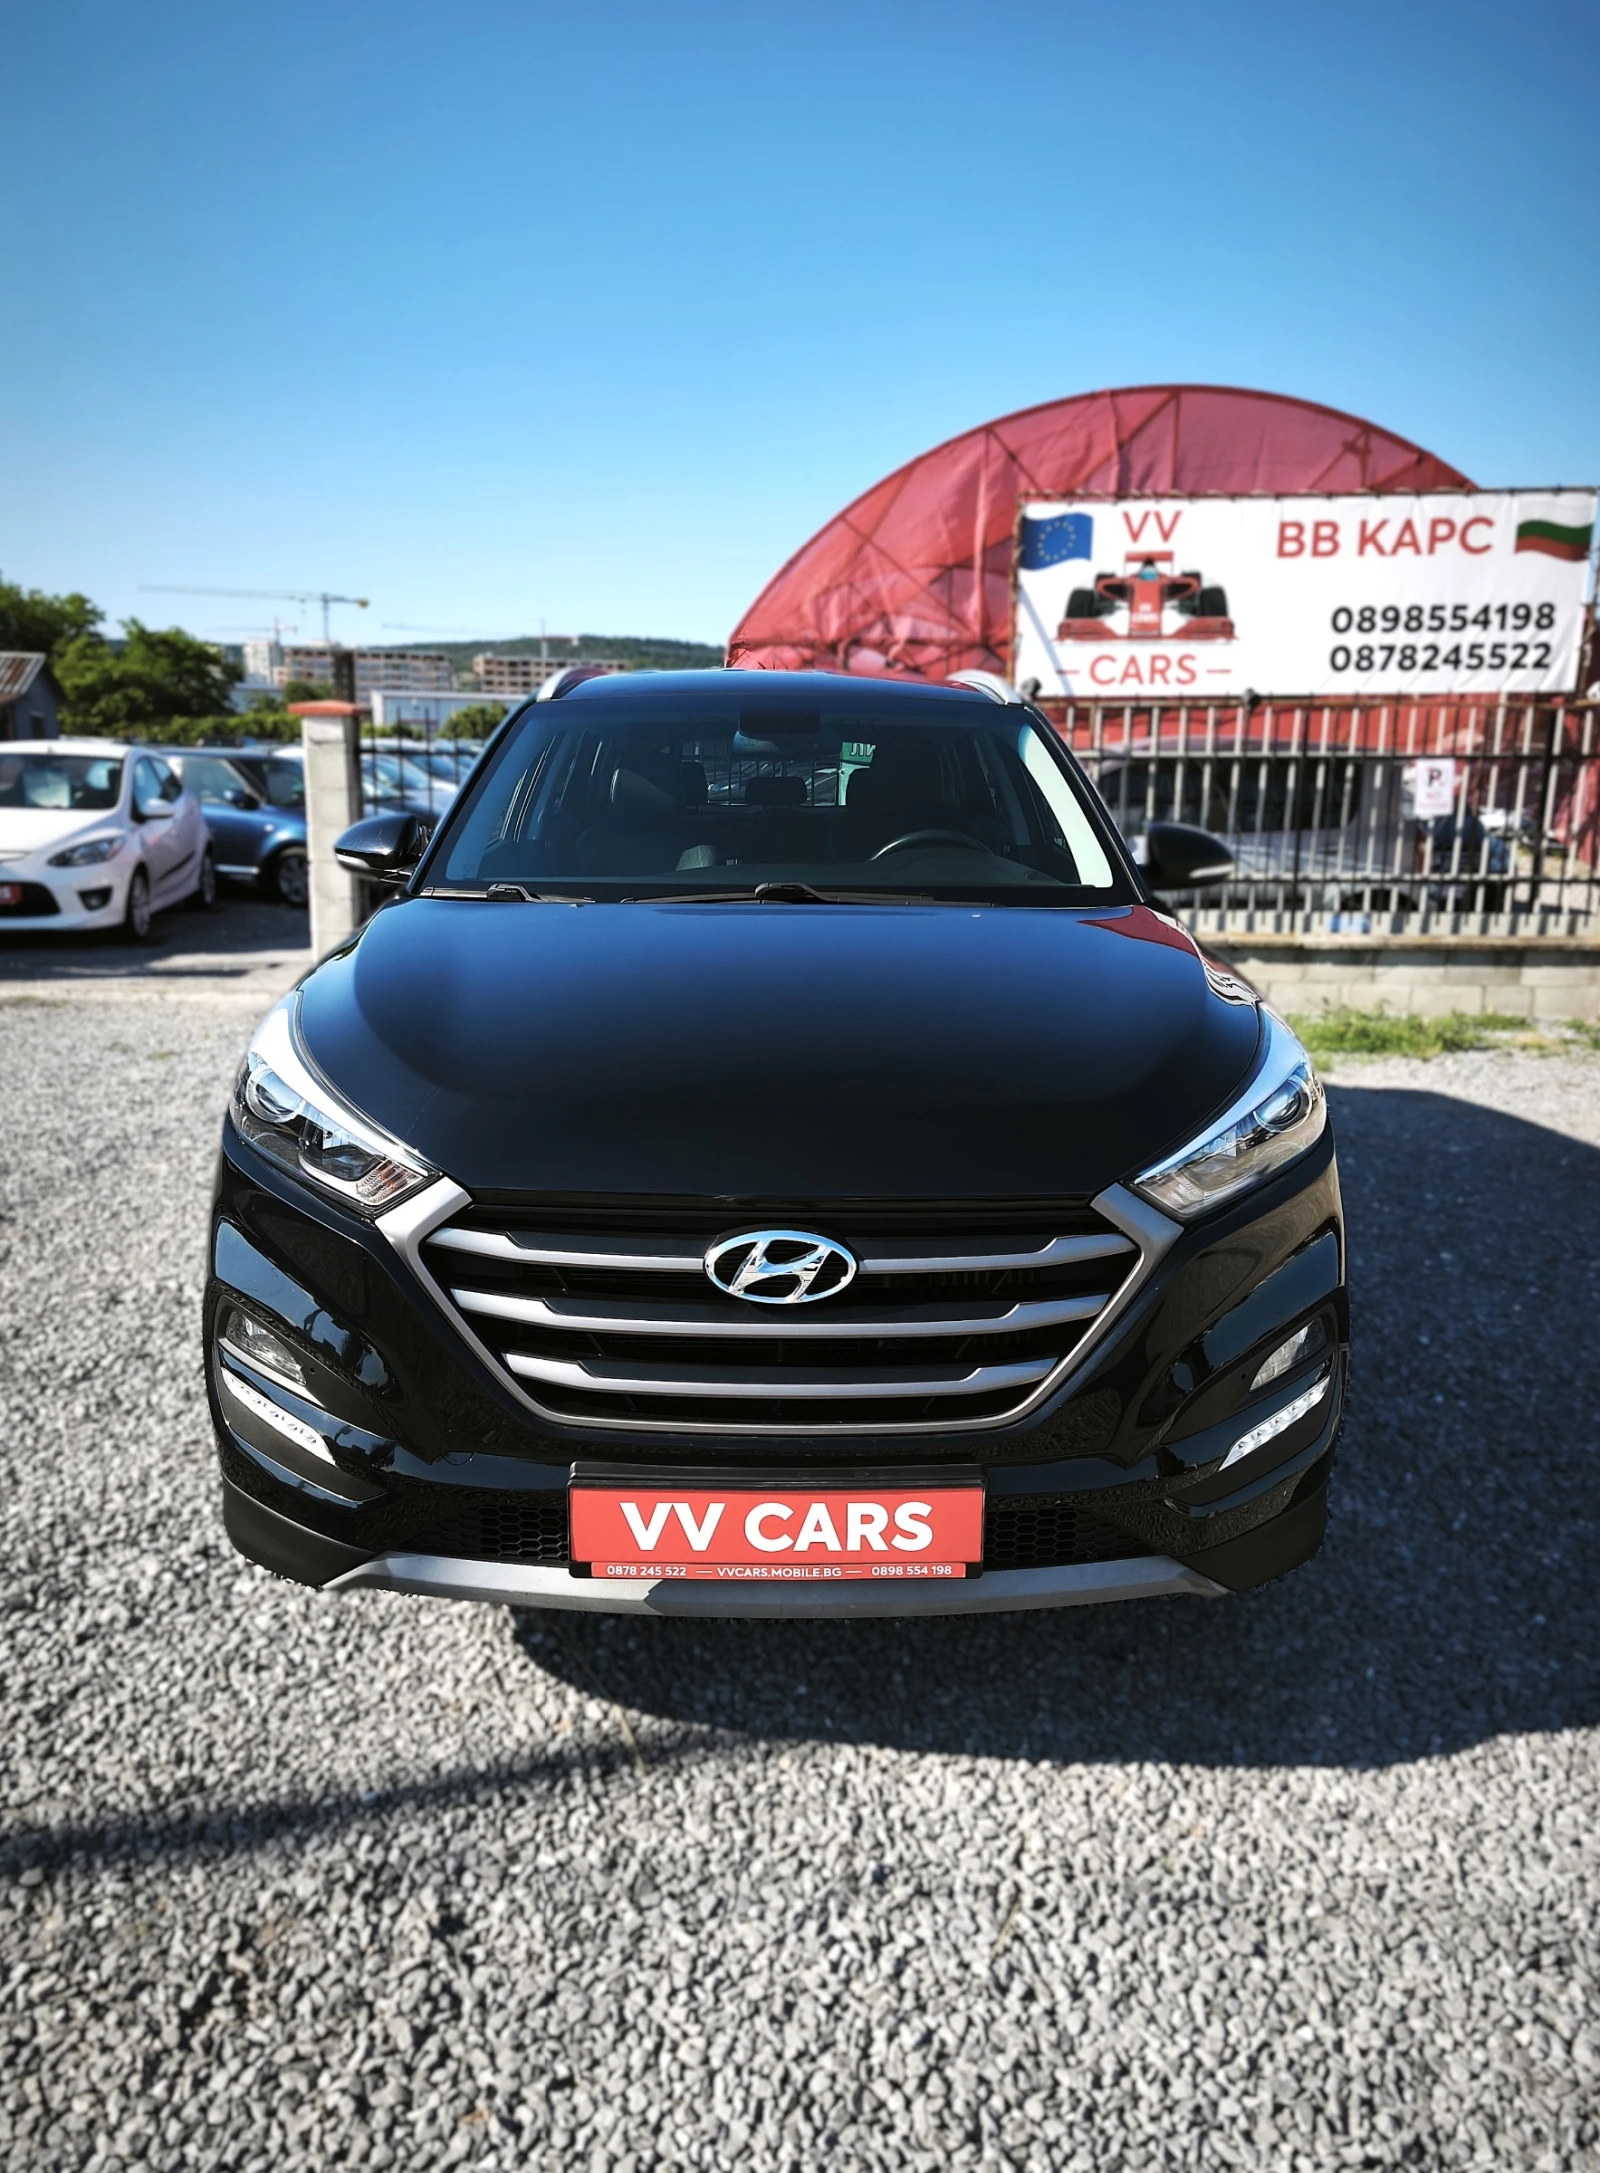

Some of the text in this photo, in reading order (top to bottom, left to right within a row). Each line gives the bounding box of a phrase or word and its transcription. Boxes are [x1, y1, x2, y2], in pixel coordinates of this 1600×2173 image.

[1122, 511, 1182, 543] VV
[1277, 516, 1494, 558] ВВ КАРС
[1331, 602, 1556, 634] 0898554198
[1088, 654, 1198, 686] CARS
[1329, 641, 1552, 673] 0878245522
[619, 1501, 933, 1553] VV CARS
[606, 1564, 952, 1578] 0878 245 522 VVCARS.MOBILE.BG 0898 554 198
